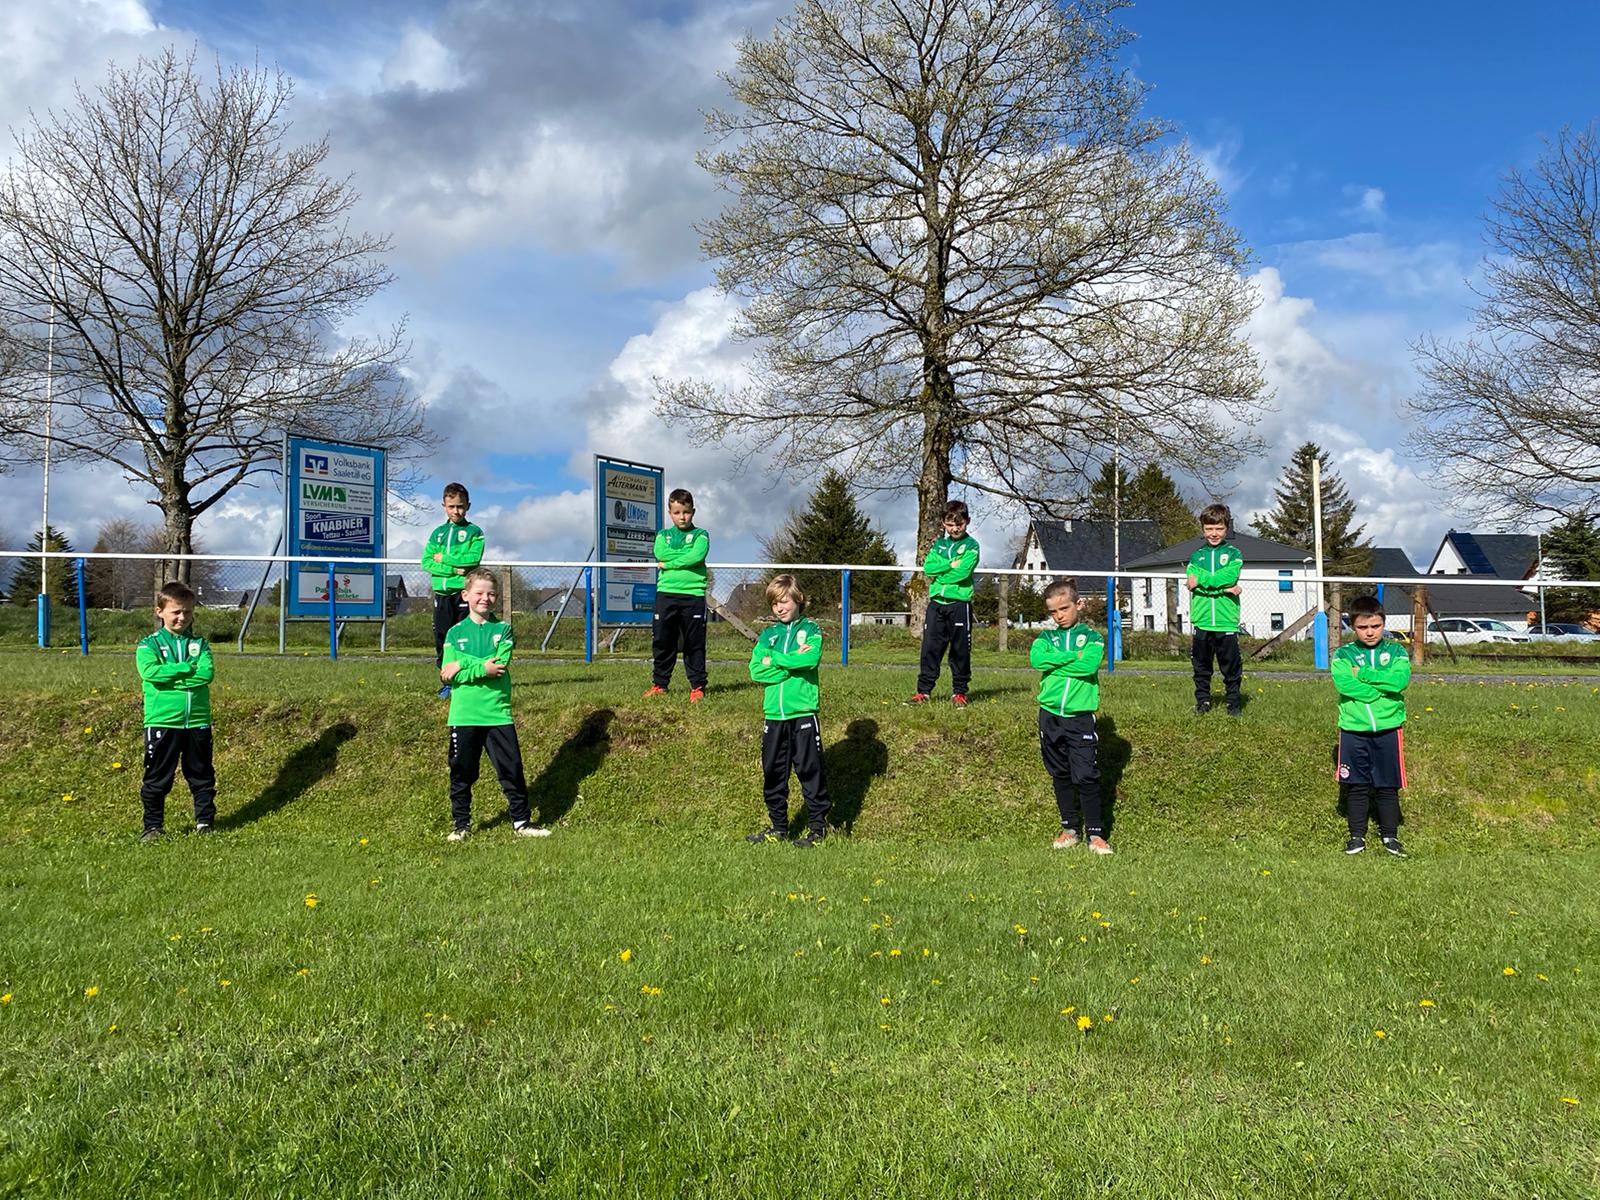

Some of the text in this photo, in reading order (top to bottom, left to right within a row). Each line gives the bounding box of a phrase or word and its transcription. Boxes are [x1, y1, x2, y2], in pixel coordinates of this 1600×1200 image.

[333, 457, 371, 470] Volksbank
[333, 468, 371, 481] Saaletal eG
[303, 483, 333, 502] LVM
[607, 480, 650, 493] ALTERMANN
[303, 500, 347, 510] VERSICHERUNG
[305, 513, 322, 521] Sport
[312, 517, 363, 534] KNABNER
[322, 527, 368, 540] Tettau Saalfeld
